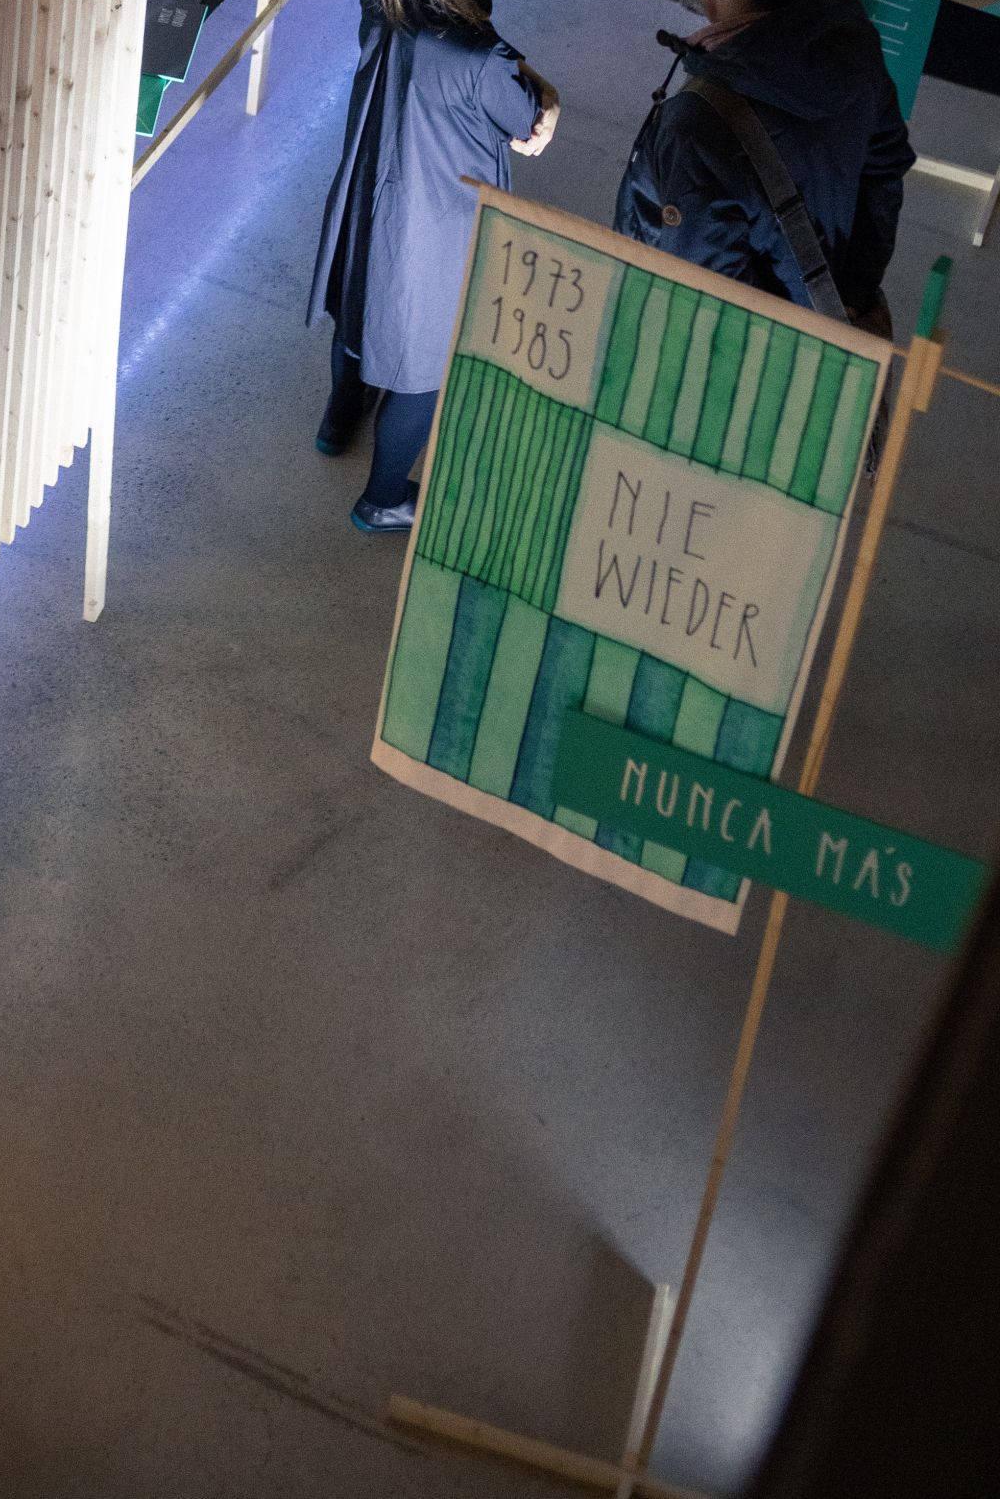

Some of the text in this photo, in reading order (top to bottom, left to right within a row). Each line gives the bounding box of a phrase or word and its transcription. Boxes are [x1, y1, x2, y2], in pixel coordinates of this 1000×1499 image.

[499, 239, 585, 313] 1973
[490, 297, 574, 381] 1985
[607, 469, 717, 561] NIE
[594, 540, 760, 668] WIEDER
[619, 757, 915, 908] NUNCA MÁS
